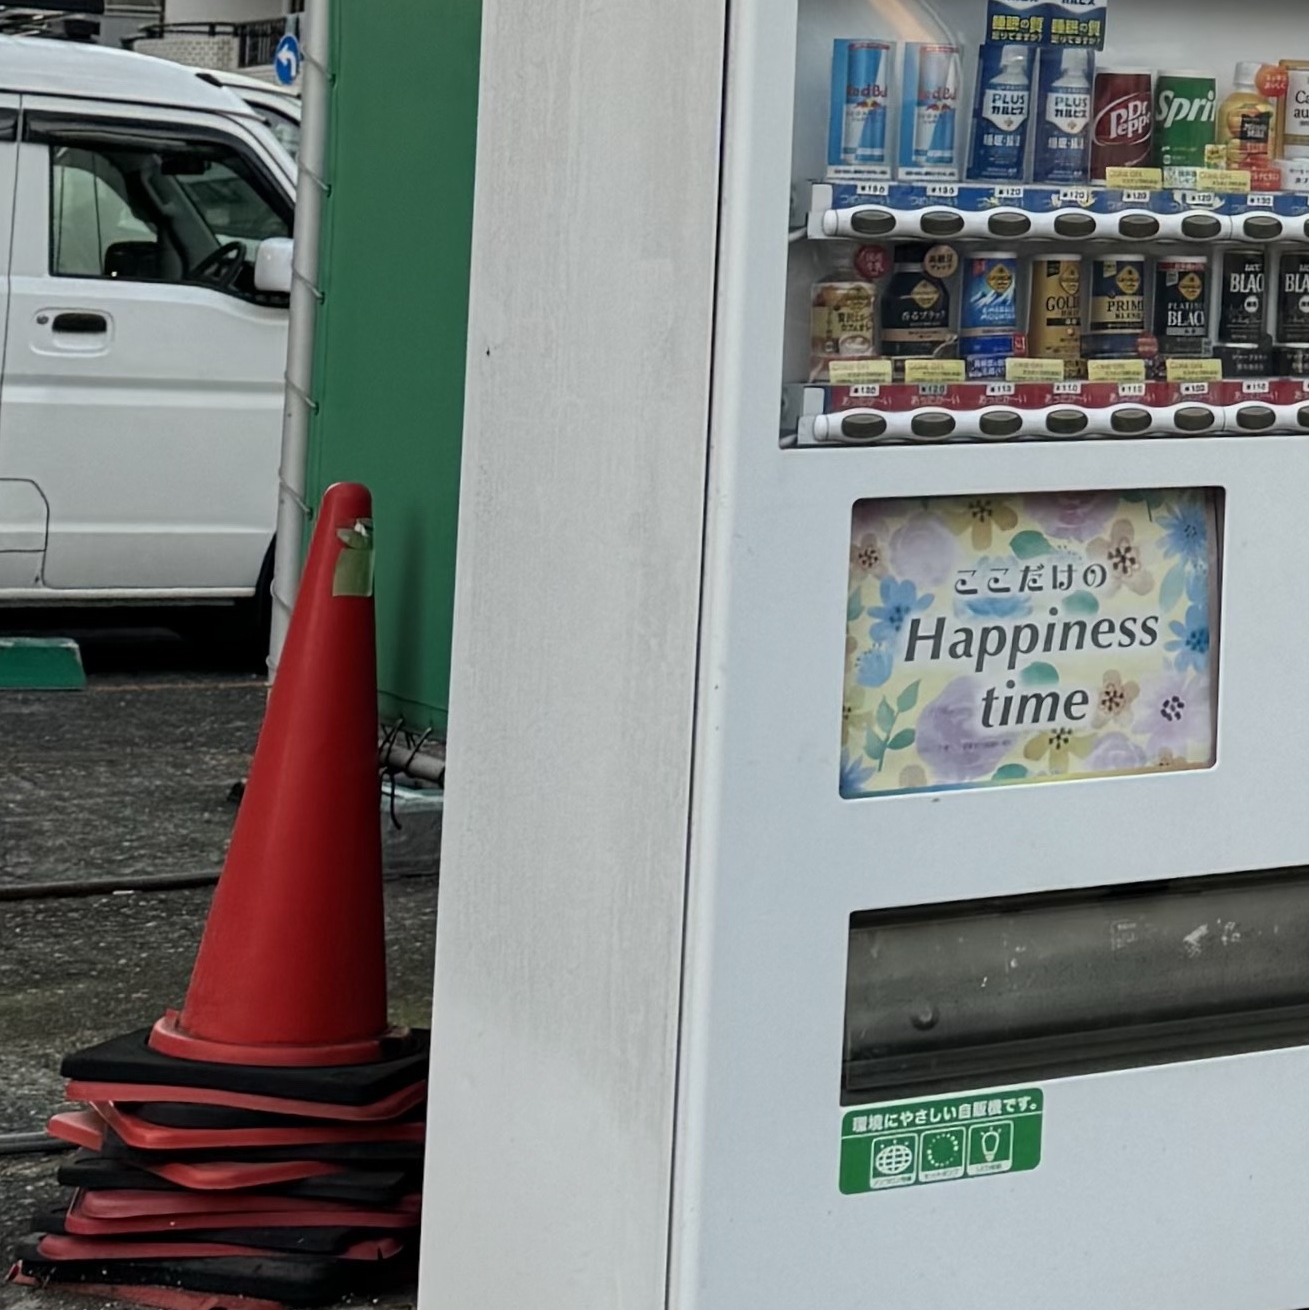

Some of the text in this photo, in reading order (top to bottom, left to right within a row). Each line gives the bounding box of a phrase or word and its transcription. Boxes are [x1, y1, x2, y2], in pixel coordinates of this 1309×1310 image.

[991, 93, 1025, 105] PLUS
[1054, 96, 1087, 108] PLUS
[991, 105, 1025, 116] カルピス
[1054, 107, 1087, 119] カルピス
[1127, 99, 1149, 118] Dr
[1293, 106, 1309, 119] au
[952, 562, 1108, 596] ここだけの
[903, 606, 1160, 674] Happiness
[981, 679, 1090, 729] time
[852, 1095, 1038, 1134] 環境にやさしい自販機です。
